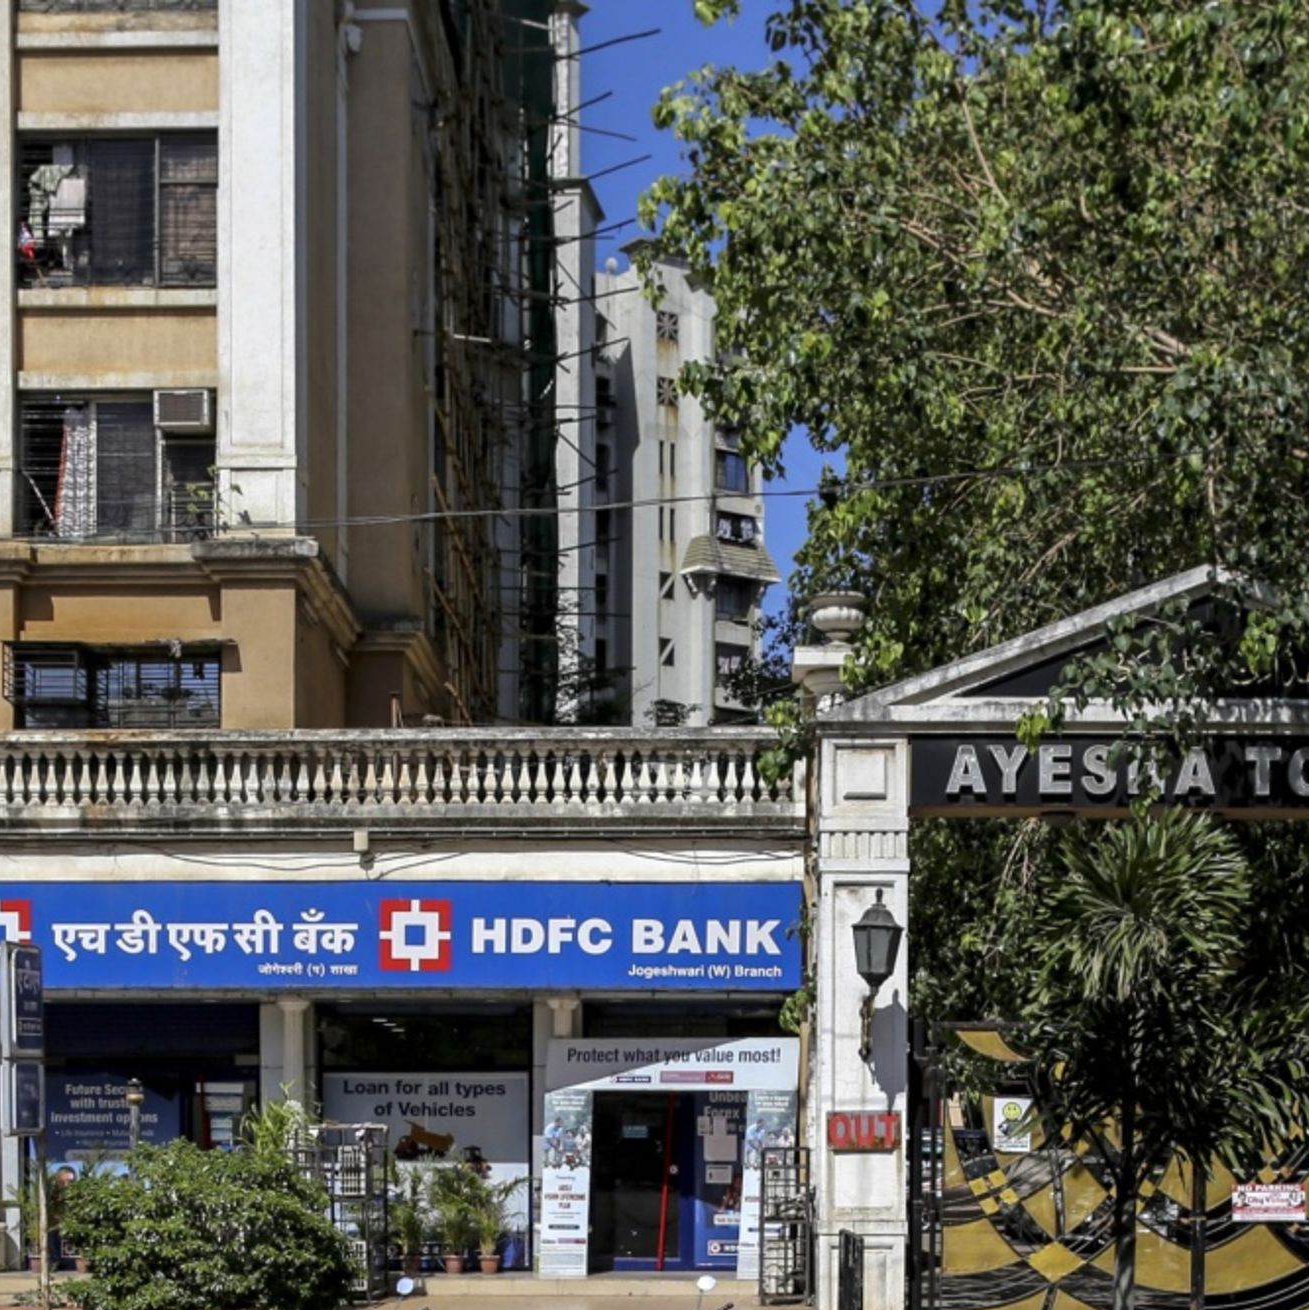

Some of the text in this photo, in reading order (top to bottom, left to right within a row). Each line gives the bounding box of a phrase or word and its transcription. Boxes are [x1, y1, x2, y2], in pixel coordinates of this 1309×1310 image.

[51, 907, 359, 962] एच डी एफ सी बँक
[471, 917, 782, 956] HDFC BANK
[628, 965, 782, 980] Jogeshwari (W) Branch
[567, 1048, 781, 1065] Protect what you value most!
[65, 1083, 101, 1095] Future
[343, 1080, 506, 1099] Loan for all types
[70, 1096, 95, 1109] with
[374, 1102, 476, 1117] of Vehicles
[116, 1113, 158, 1126] opons
[828, 1113, 899, 1148] OUT
[1237, 1183, 1301, 1192] NO PARKING
